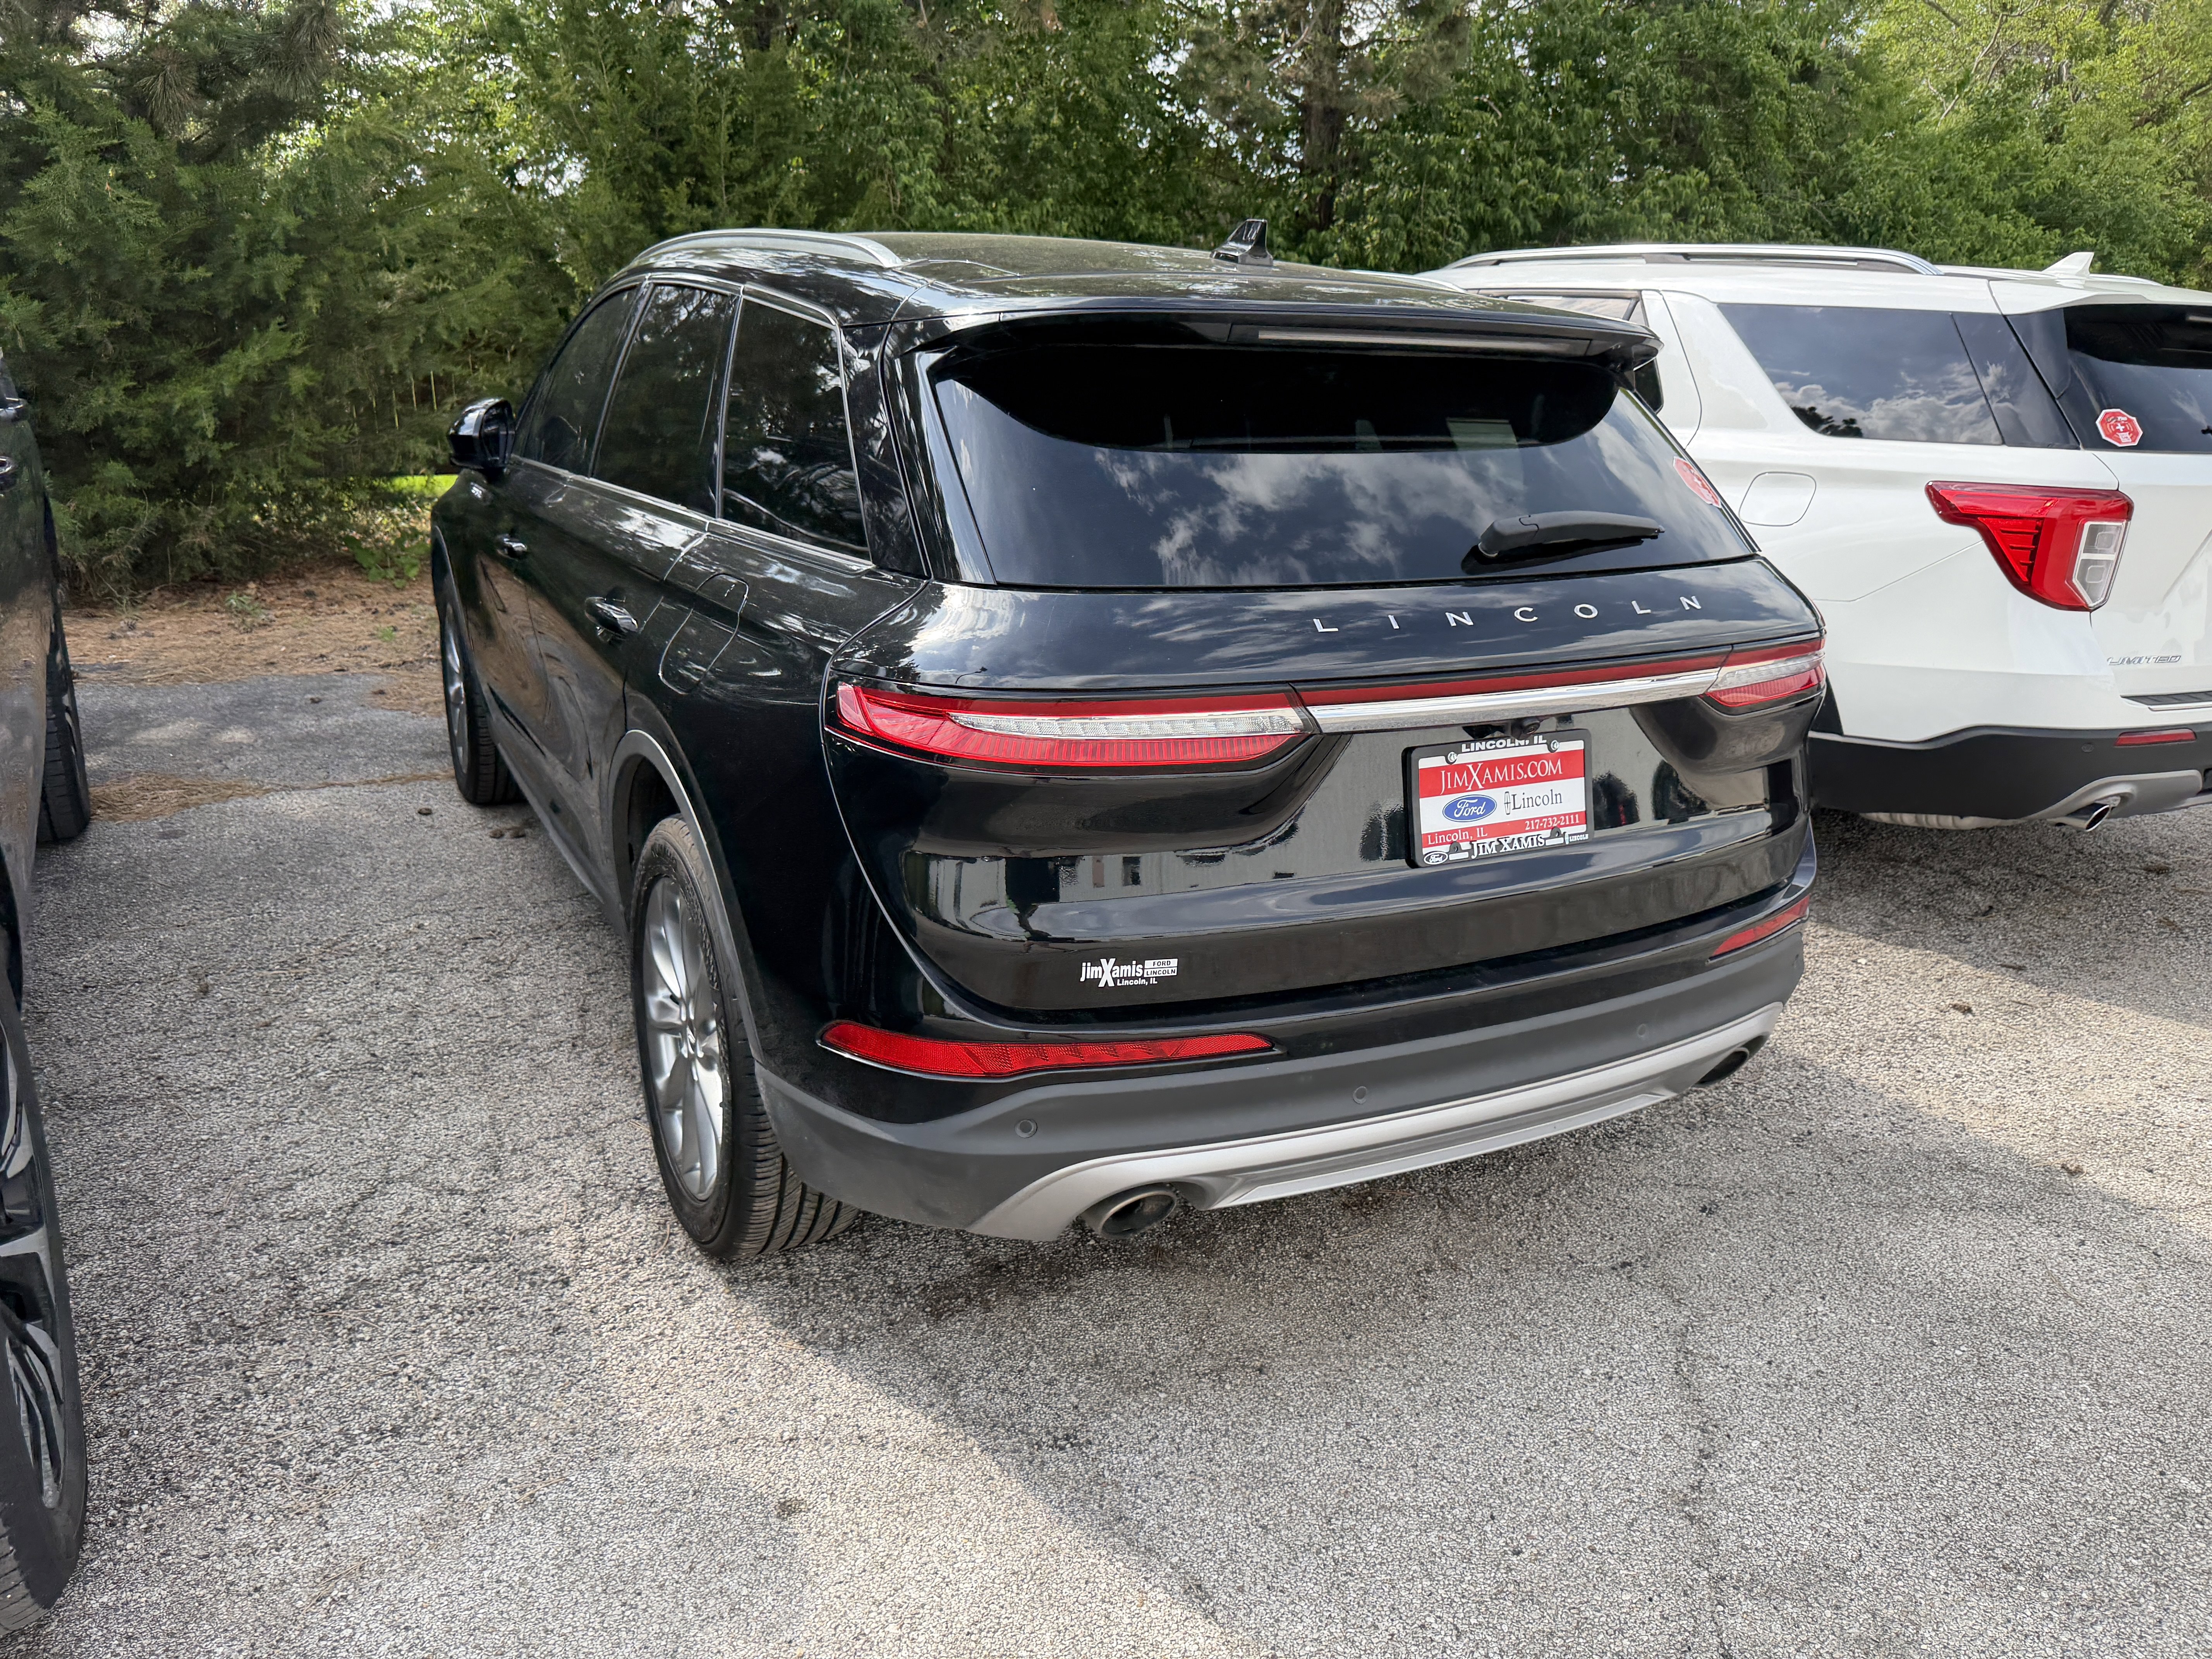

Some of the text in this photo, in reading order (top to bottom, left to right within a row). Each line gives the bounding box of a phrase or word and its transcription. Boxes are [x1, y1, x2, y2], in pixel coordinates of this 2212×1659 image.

[1313, 596, 1702, 632] LINCOLN
[2107, 655, 2181, 665] LIMITED
[1462, 735, 1547, 752] LINCOLN, IL
[1454, 799, 1486, 817] Ford
[1511, 789, 1563, 810] Lincoln
[1525, 814, 1580, 830] 217-732-2111
[1428, 828, 1487, 845] Lincoln, IL
[1569, 834, 1589, 842] LINCOLN
[1471, 835, 1546, 859] JIM XAMIS
